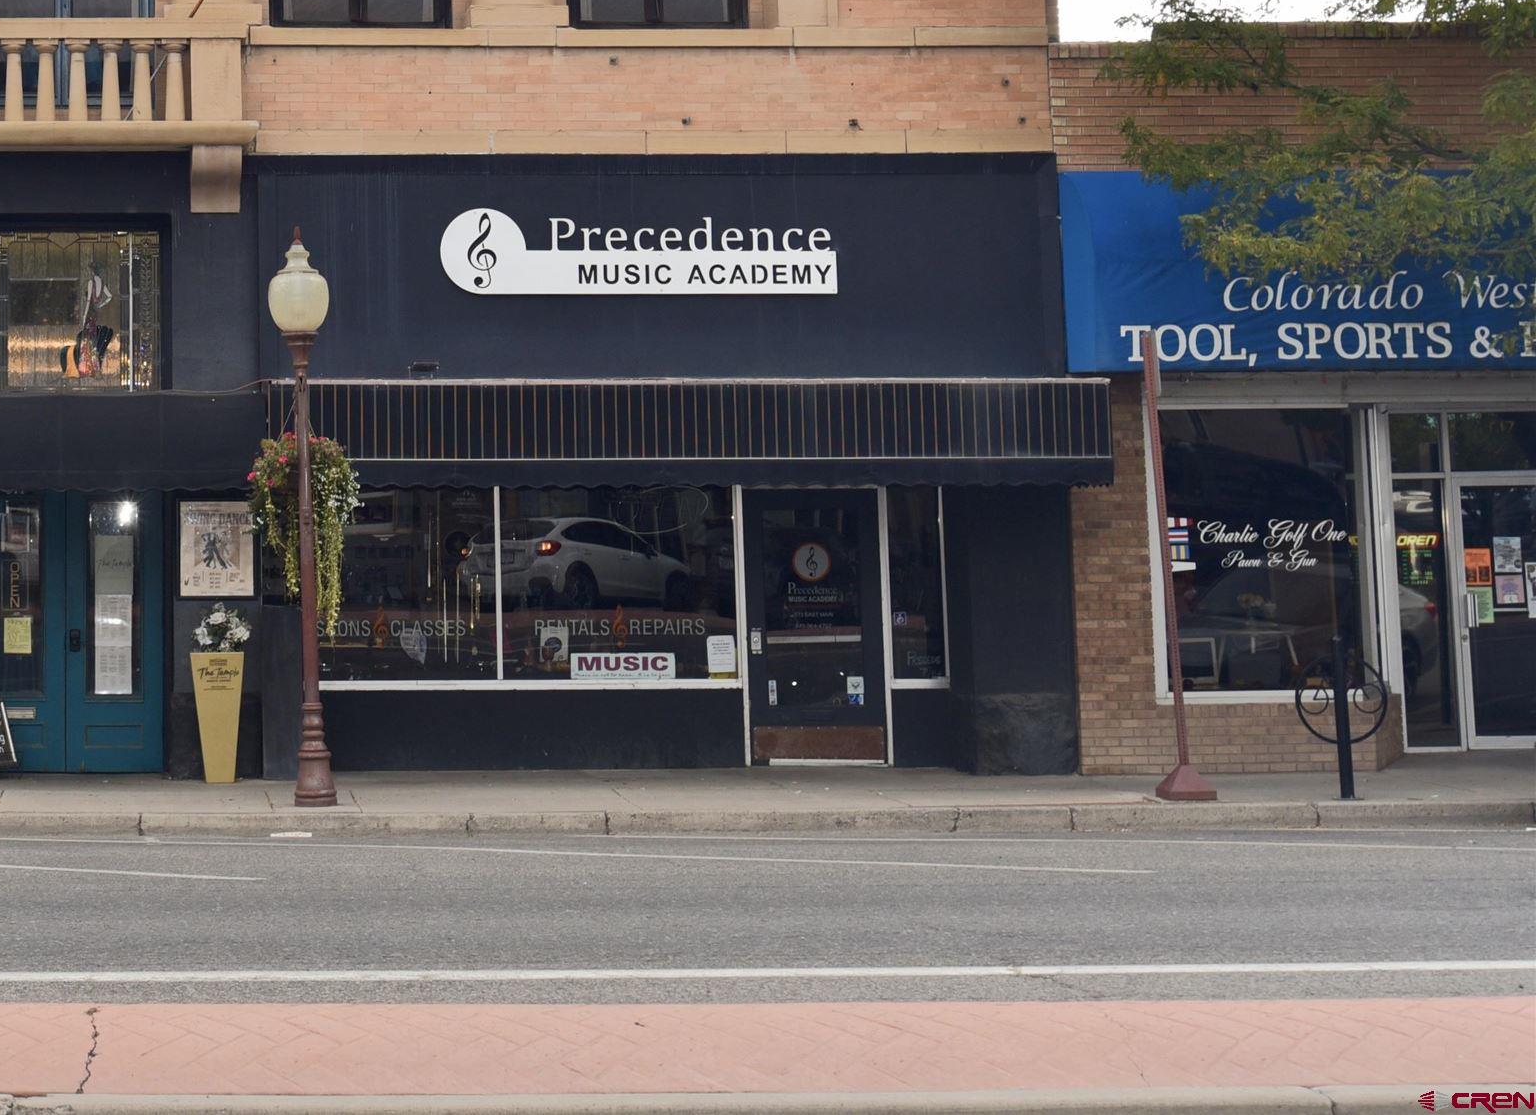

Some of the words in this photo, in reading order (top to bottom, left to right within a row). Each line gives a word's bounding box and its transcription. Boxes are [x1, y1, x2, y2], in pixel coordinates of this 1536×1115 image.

[549, 216, 833, 252] Precedence
[578, 264, 672, 285] MUSIC
[687, 264, 833, 285] ACADEMY
[1223, 270, 1424, 312] Colorado
[1120, 323, 1258, 367] TOOL,
[1277, 321, 1453, 360] SPORTS
[1470, 326, 1504, 359] &
[1197, 520, 1260, 544] Charlie
[1263, 519, 1309, 550] Golf
[1311, 519, 1347, 542] One
[1396, 535, 1437, 546] OPEN
[1221, 550, 1262, 568] Pawn
[1267, 552, 1283, 567] &
[1286, 549, 1318, 571] Gun
[9, 562, 20, 609] OPEN
[788, 581, 838, 595] Precedence
[390, 620, 466, 636] CLASSES
[630, 618, 706, 636] REPAIRS
[577, 656, 669, 671] MUSIC
